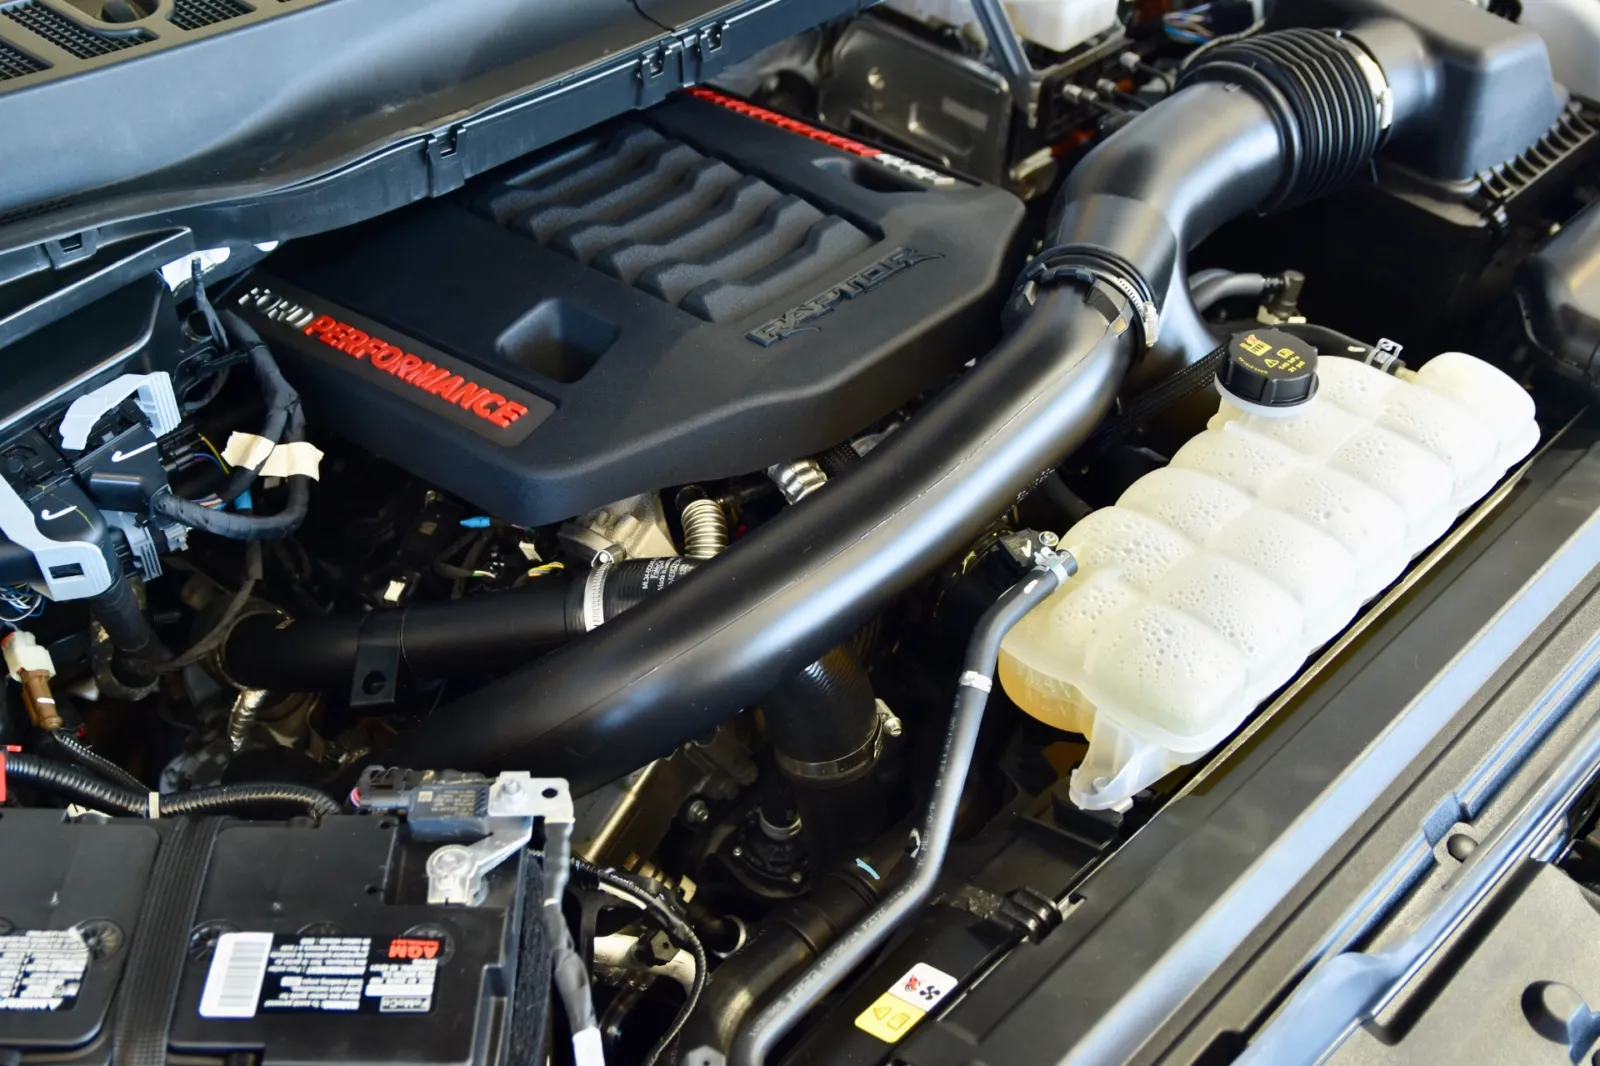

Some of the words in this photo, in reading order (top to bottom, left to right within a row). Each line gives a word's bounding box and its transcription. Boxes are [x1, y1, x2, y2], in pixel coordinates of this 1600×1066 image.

[238, 287, 314, 328] FORD
[303, 314, 529, 429] PERFORMANCE
[744, 246, 946, 348] RAPTOR
